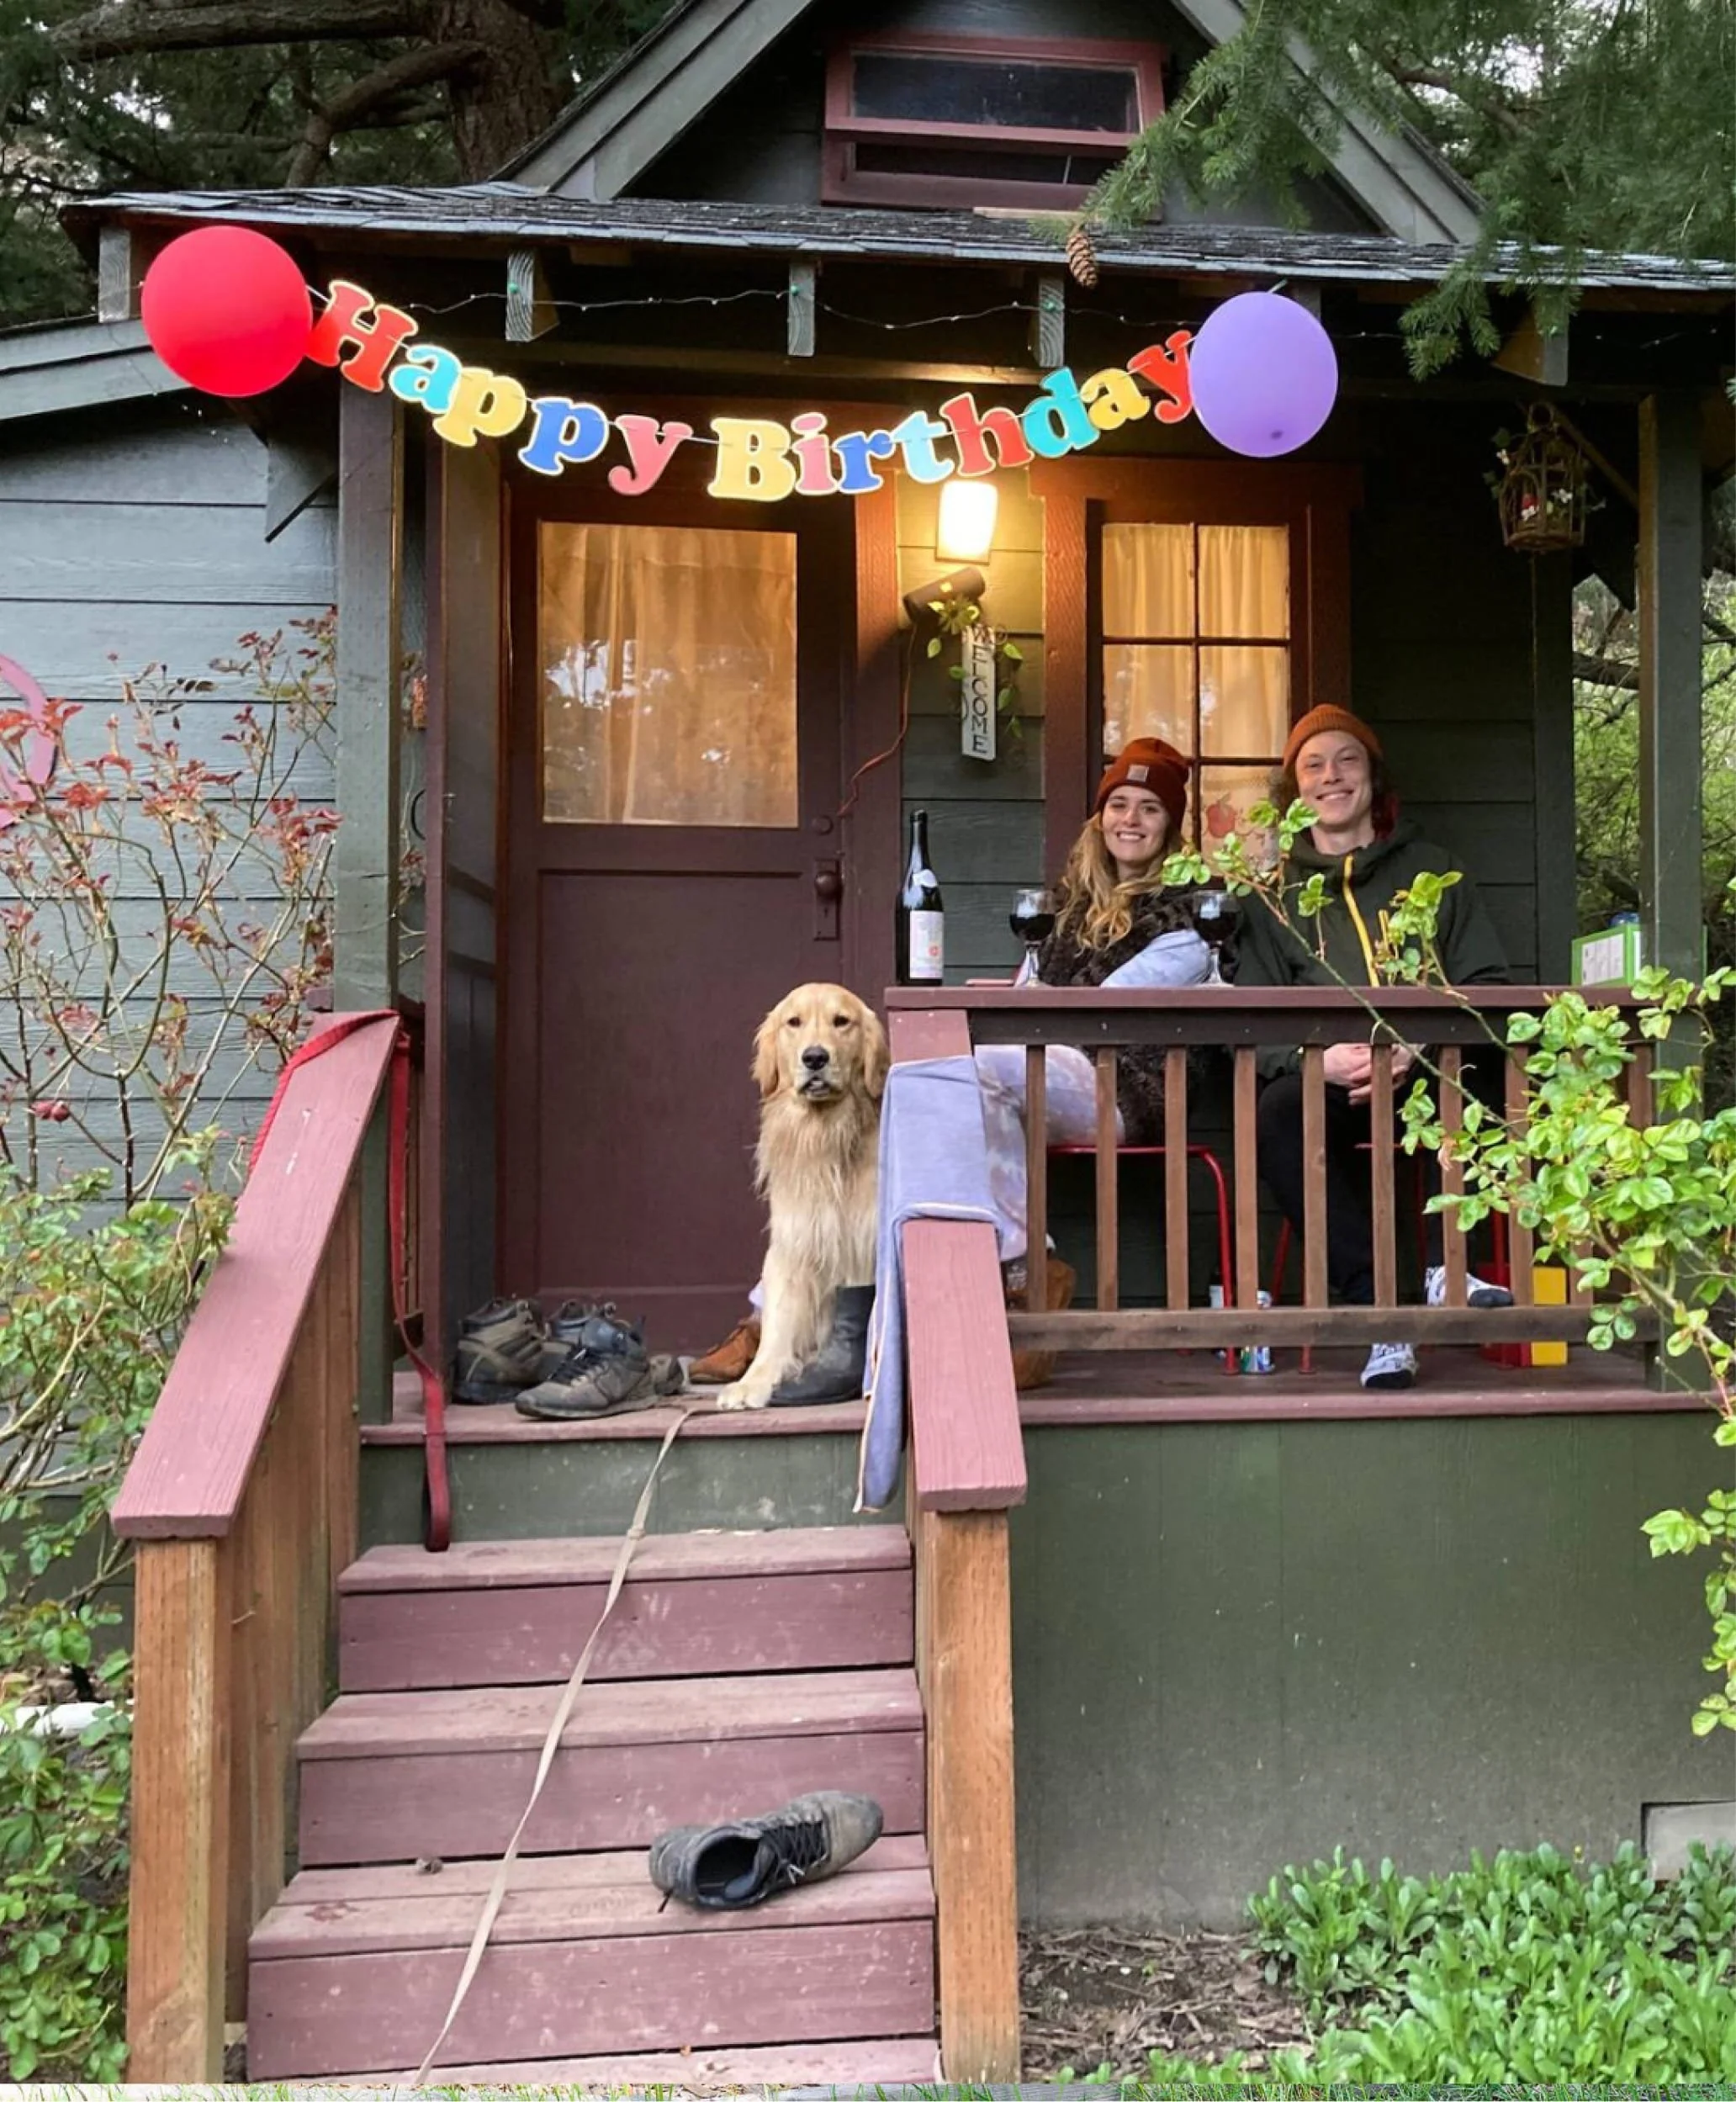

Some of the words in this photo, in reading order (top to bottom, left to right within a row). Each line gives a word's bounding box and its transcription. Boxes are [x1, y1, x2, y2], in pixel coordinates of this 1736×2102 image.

[305, 280, 693, 496] Happy
[707, 330, 1193, 502] Birthday
[971, 623, 990, 754] WELCOME
